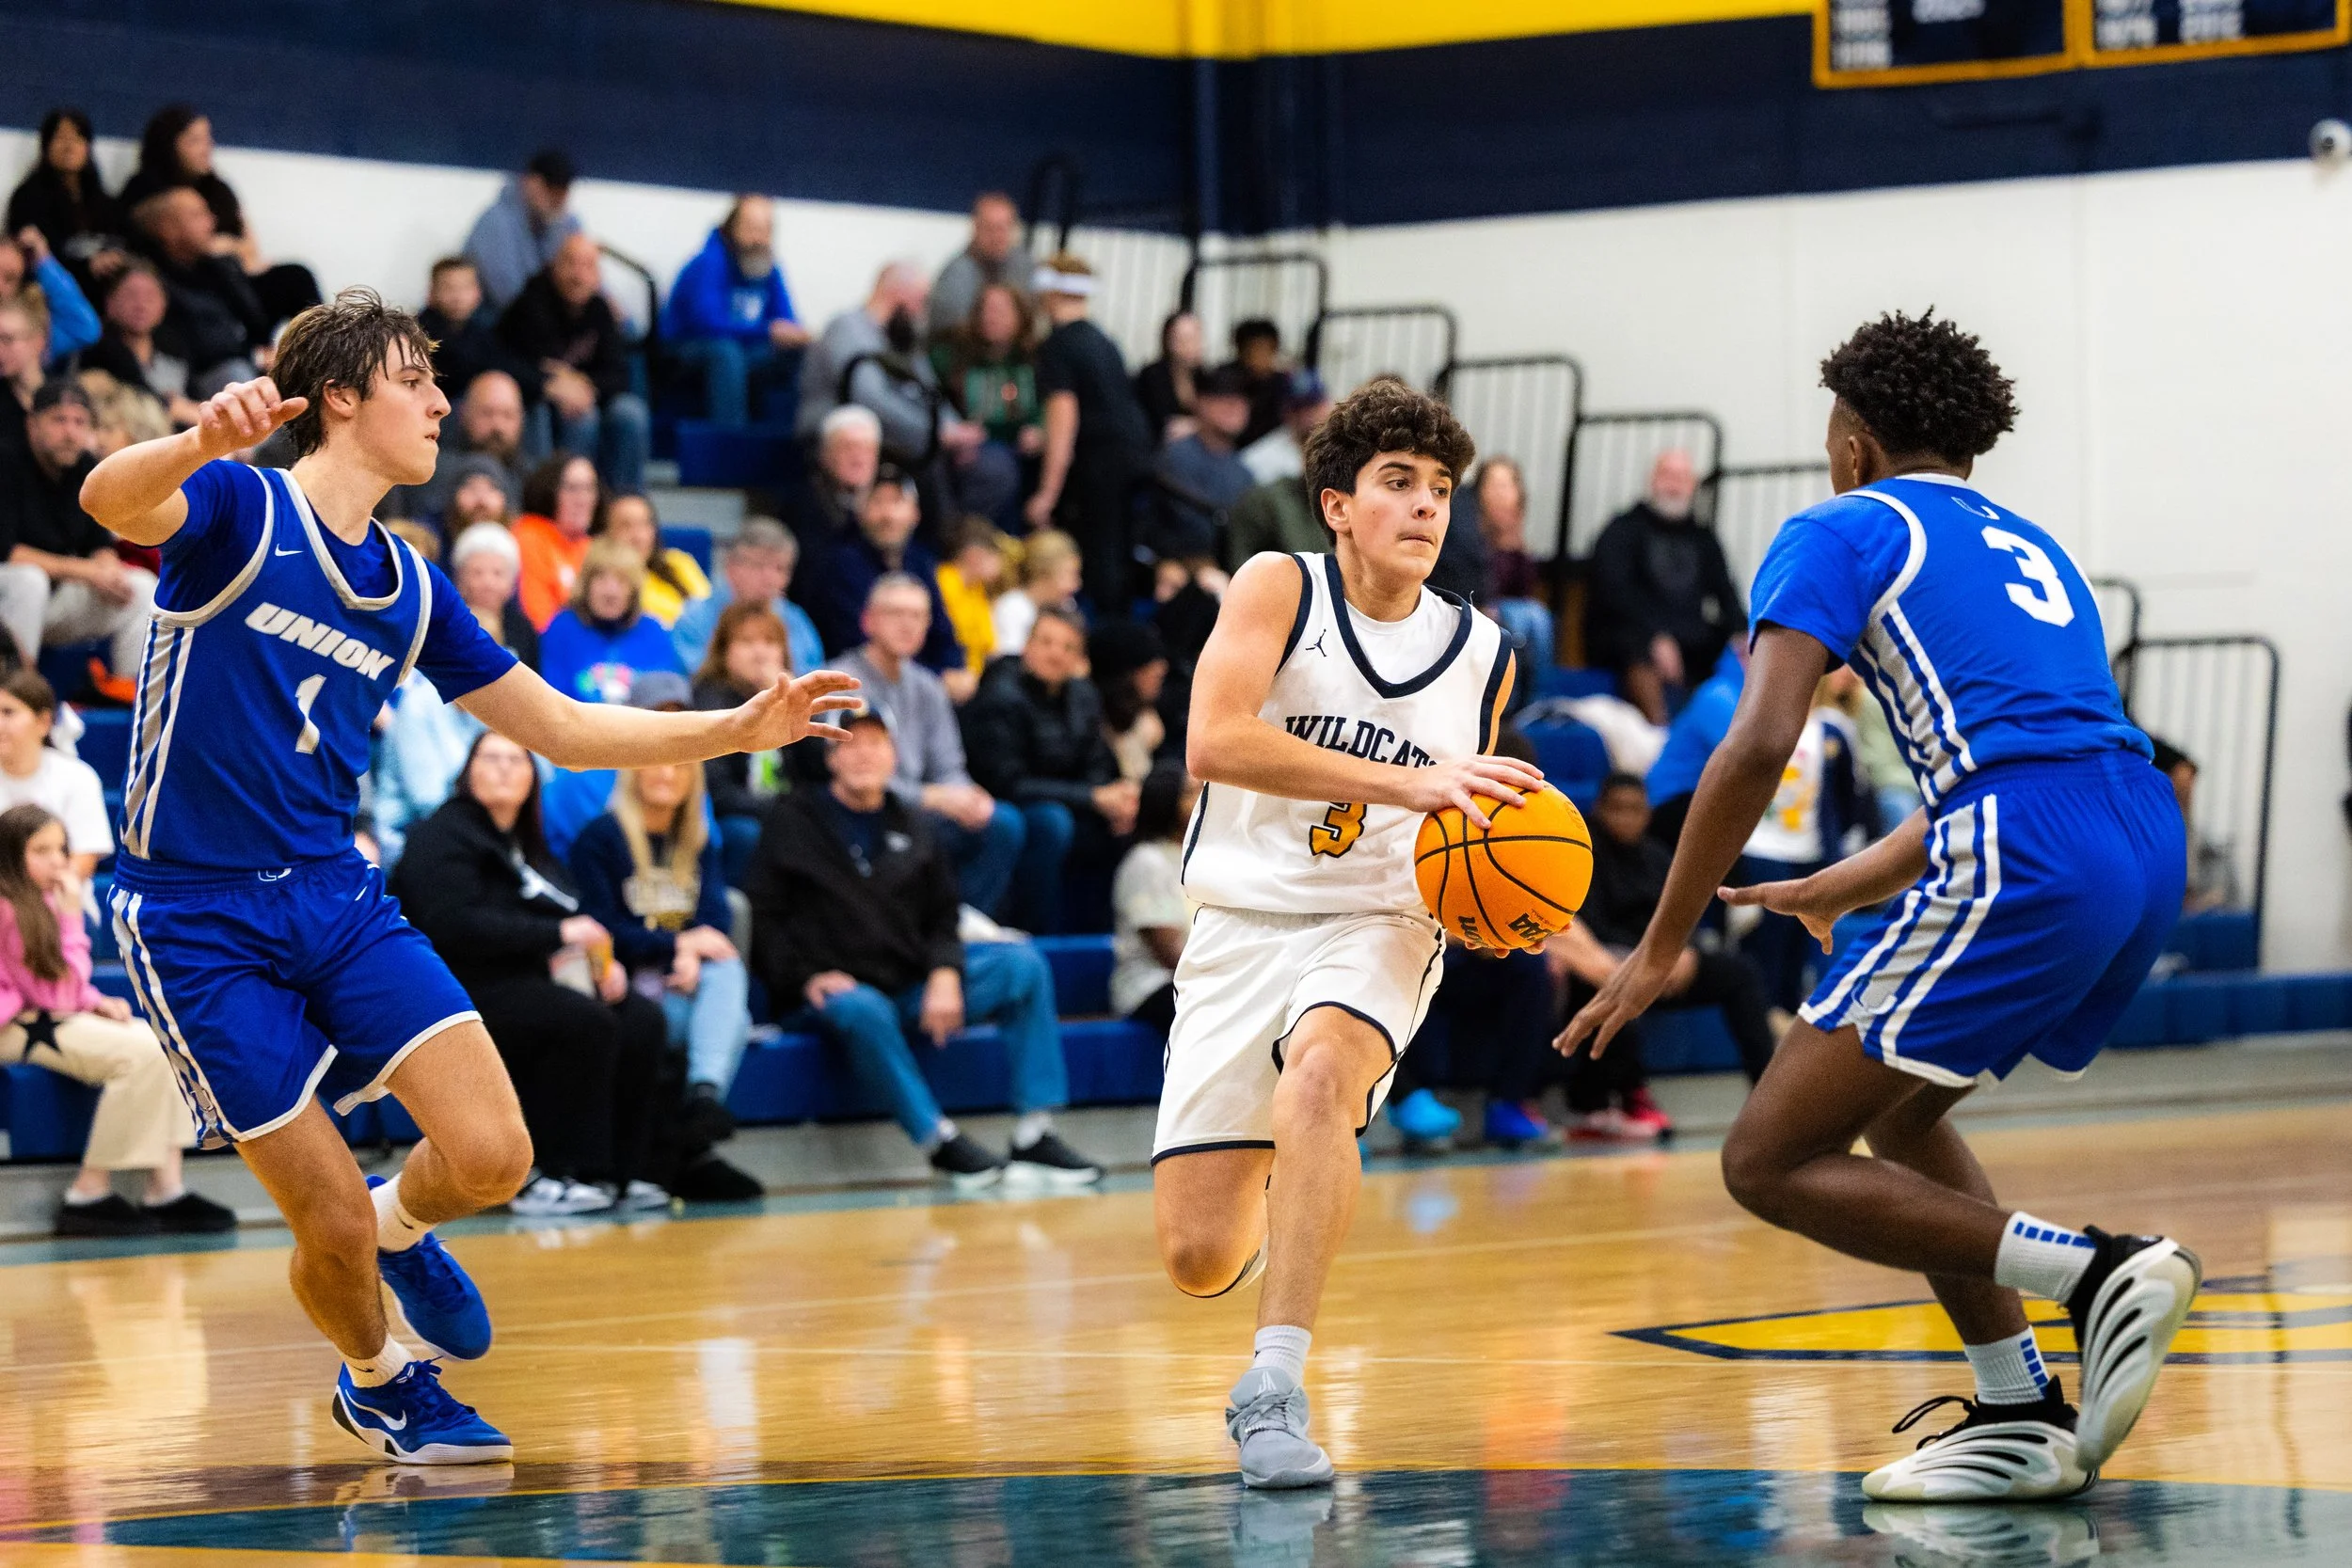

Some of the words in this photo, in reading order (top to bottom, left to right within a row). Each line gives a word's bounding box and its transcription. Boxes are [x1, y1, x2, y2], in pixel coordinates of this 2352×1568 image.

[1980, 525, 2075, 628] 3
[244, 601, 396, 682] UNION
[294, 673, 327, 755] 1
[1285, 715, 1438, 768] WILDCAT
[1309, 800, 1368, 859] 3
